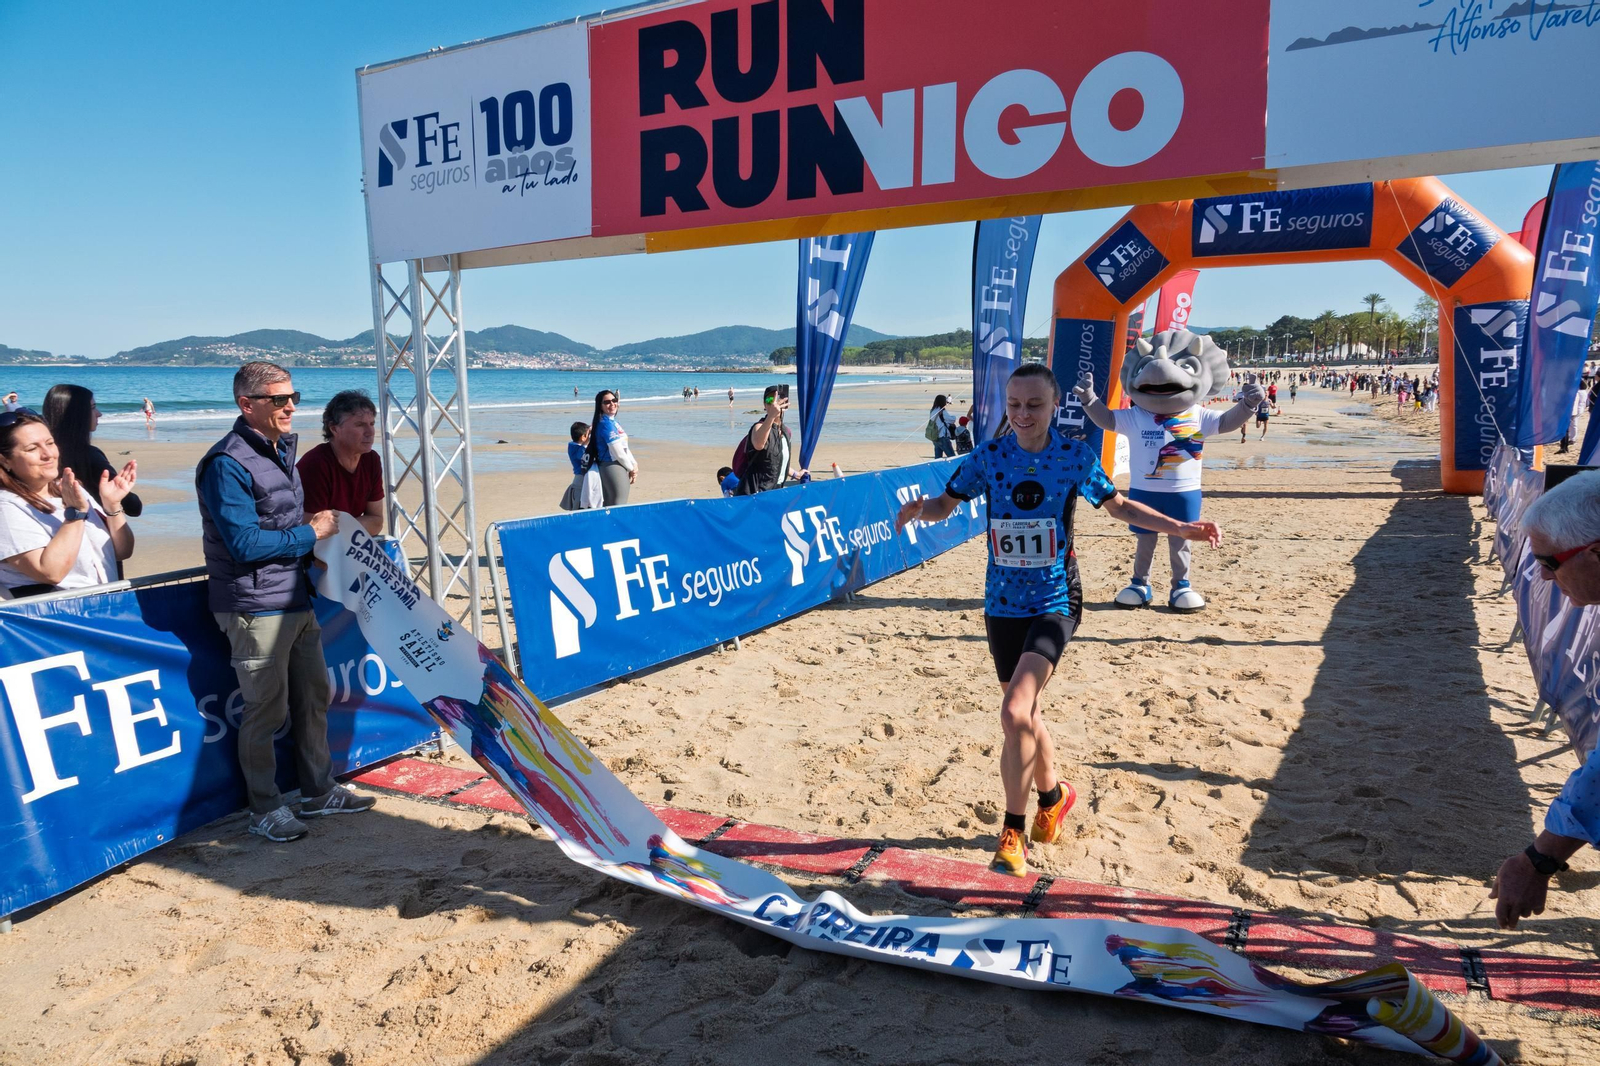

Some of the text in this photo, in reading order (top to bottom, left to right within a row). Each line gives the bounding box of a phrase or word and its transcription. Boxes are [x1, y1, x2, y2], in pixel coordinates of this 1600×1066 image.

[1428, 1, 1521, 55] Alfonso
[638, 0, 864, 116] RUN
[413, 111, 462, 168] FE
[480, 82, 573, 157] 100
[410, 165, 470, 195] seguros
[485, 145, 574, 183] años
[502, 160, 578, 197] a tu lado
[1238, 201, 1365, 234] FE seguros
[1444, 223, 1477, 256] FE
[1110, 240, 1142, 267] FE
[1118, 245, 1155, 282] seguros
[1427, 237, 1471, 271] seguros
[1542, 229, 1595, 287] FE
[980, 266, 1017, 316] FE
[1077, 323, 1095, 384] eguros
[1480, 344, 1517, 389] FE
[805, 505, 892, 563] FE seguros
[1000, 534, 1042, 554] 611
[345, 546, 418, 611] PRAIA DE SAMIL
[351, 529, 421, 600] CARREIRA
[602, 538, 762, 621] FE seguros
[364, 580, 382, 610] FE
[400, 633, 436, 672] SAMIL
[410, 629, 446, 666] ATLETISMO
[0, 650, 181, 804] FE
[753, 894, 940, 957] CARREIRA
[1010, 939, 1072, 986] FE
